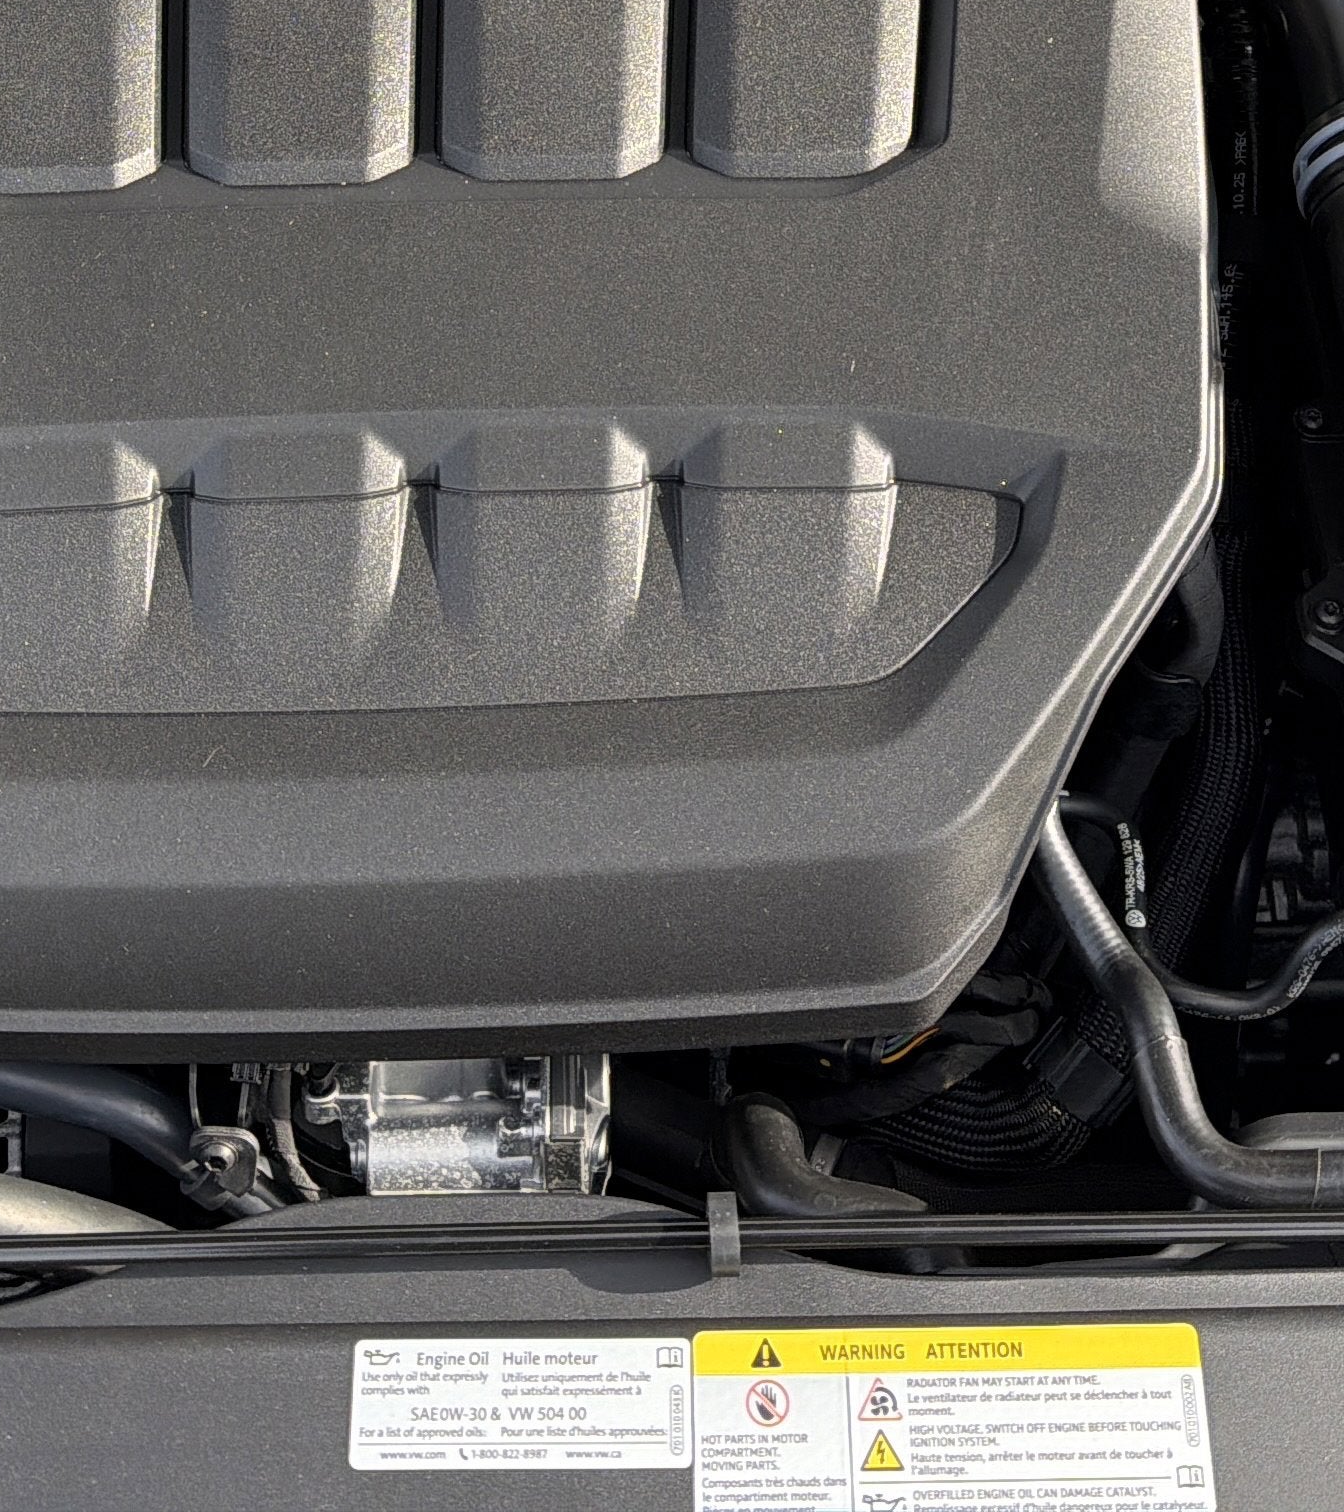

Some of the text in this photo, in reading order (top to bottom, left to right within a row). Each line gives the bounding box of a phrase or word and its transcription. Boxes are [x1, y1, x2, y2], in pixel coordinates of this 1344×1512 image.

[819, 1341, 1024, 1361] WARNING ATTENTION
[417, 1352, 598, 1370] Engine Oil Huile moteur
[362, 1371, 489, 1384] Use only oil that expressly
[502, 1371, 651, 1385] Utilisez uniquement de l'huile
[907, 1375, 1100, 1388] RADIATOR FAN MAY START AT ANY TIME.
[361, 1386, 430, 1397] complies with
[501, 1386, 518, 1399] qui
[521, 1386, 560, 1396] satisfait
[635, 1386, 642, 1395] à
[907, 1389, 1172, 1404] Le ventilateur de radiateur peut se déclencher à tout
[491, 1407, 501, 1421] &
[508, 1407, 534, 1421] VW
[538, 1407, 564, 1420] 504
[569, 1406, 587, 1420] 00
[908, 1407, 955, 1416] moment.
[359, 1427, 487, 1439] For a list of approved oils:
[501, 1427, 524, 1437] Pour
[526, 1428, 545, 1437] une
[547, 1426, 567, 1437] liste
[569, 1426, 606, 1437] d'huiles
[909, 1425, 934, 1435] HIGH
[985, 1423, 1024, 1434] SWITCH
[1027, 1423, 1046, 1433] OFF
[1048, 1422, 1086, 1433] ENGINE
[1088, 1421, 1127, 1432] BEFORE
[1129, 1421, 1182, 1431] TOUCHING
[701, 1434, 808, 1445] HOT PARTS IN MOTOR
[910, 1437, 1000, 1447] IGNITION SYSTEM.
[380, 1449, 622, 1460] www.vw.com 1-800-822-8987 www.vw.ca
[701, 1447, 781, 1458] COMPARTMENT.
[702, 1460, 781, 1471] MOVING PARTS.
[702, 1476, 847, 1489] Composants très chauds dans
[703, 1490, 832, 1504] le compartiment moteur.
